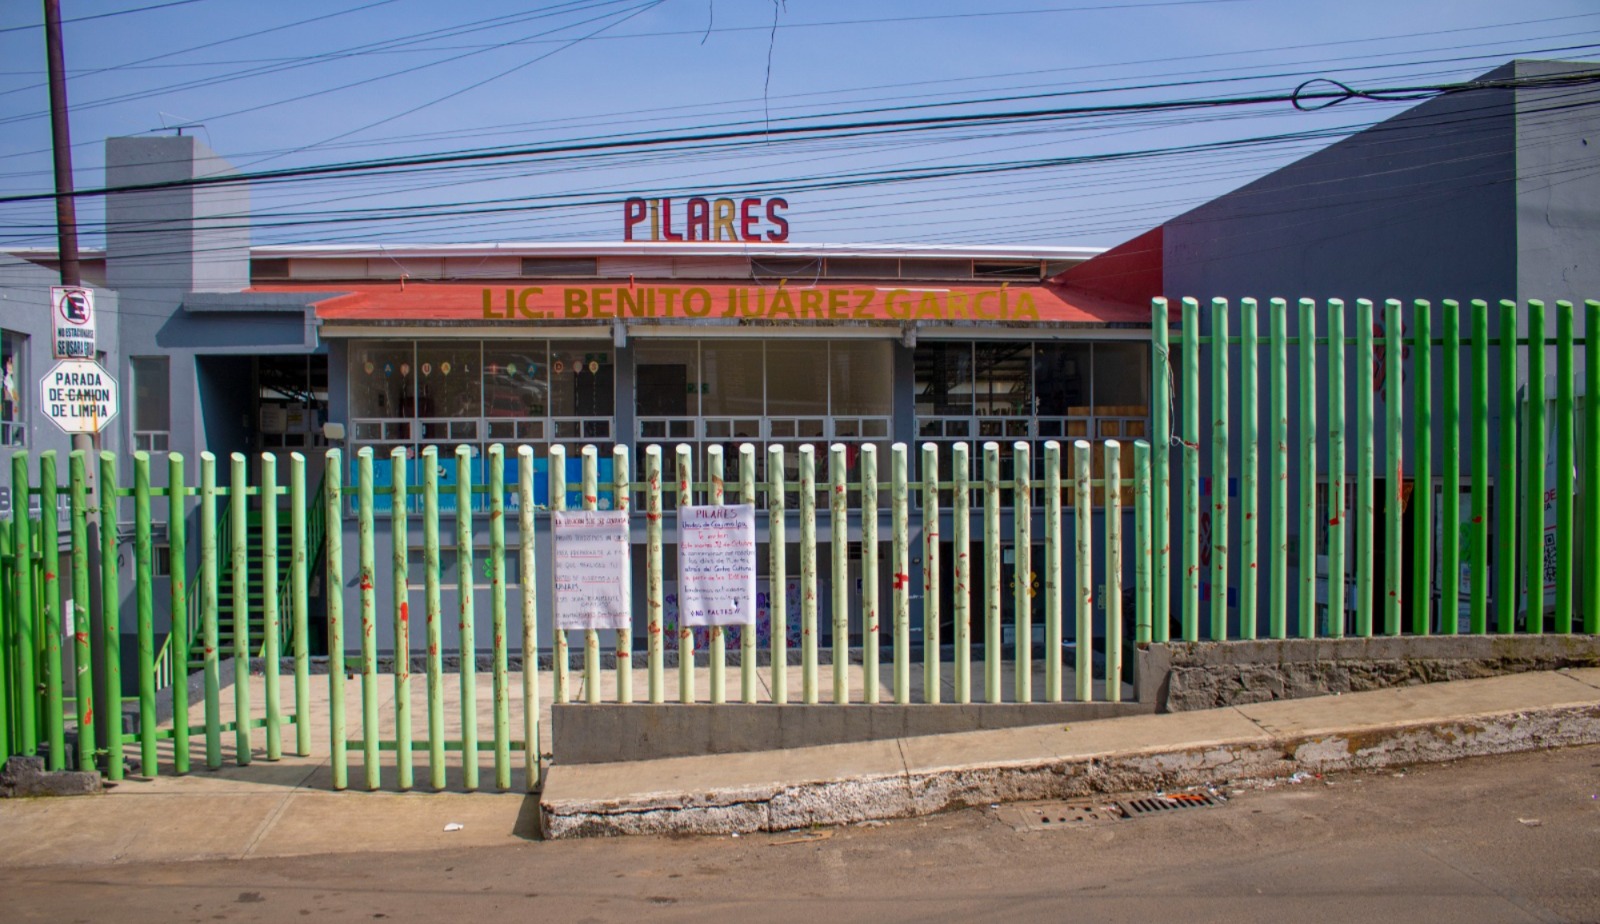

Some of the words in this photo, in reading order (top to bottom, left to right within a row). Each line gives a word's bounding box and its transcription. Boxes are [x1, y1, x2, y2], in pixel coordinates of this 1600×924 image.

[482, 287, 554, 318] LIC.
[564, 287, 713, 318] BENITO
[720, 277, 876, 319] JUÁREZ
[884, 282, 1040, 320] GARCÍA
[57, 340, 65, 355] SE
[56, 372, 102, 385] PARADA
[49, 388, 64, 401] DE
[67, 388, 110, 401] CAMION
[52, 404, 67, 417] DE
[71, 404, 107, 417] LIMPIA
[696, 509, 738, 519] PILARES
